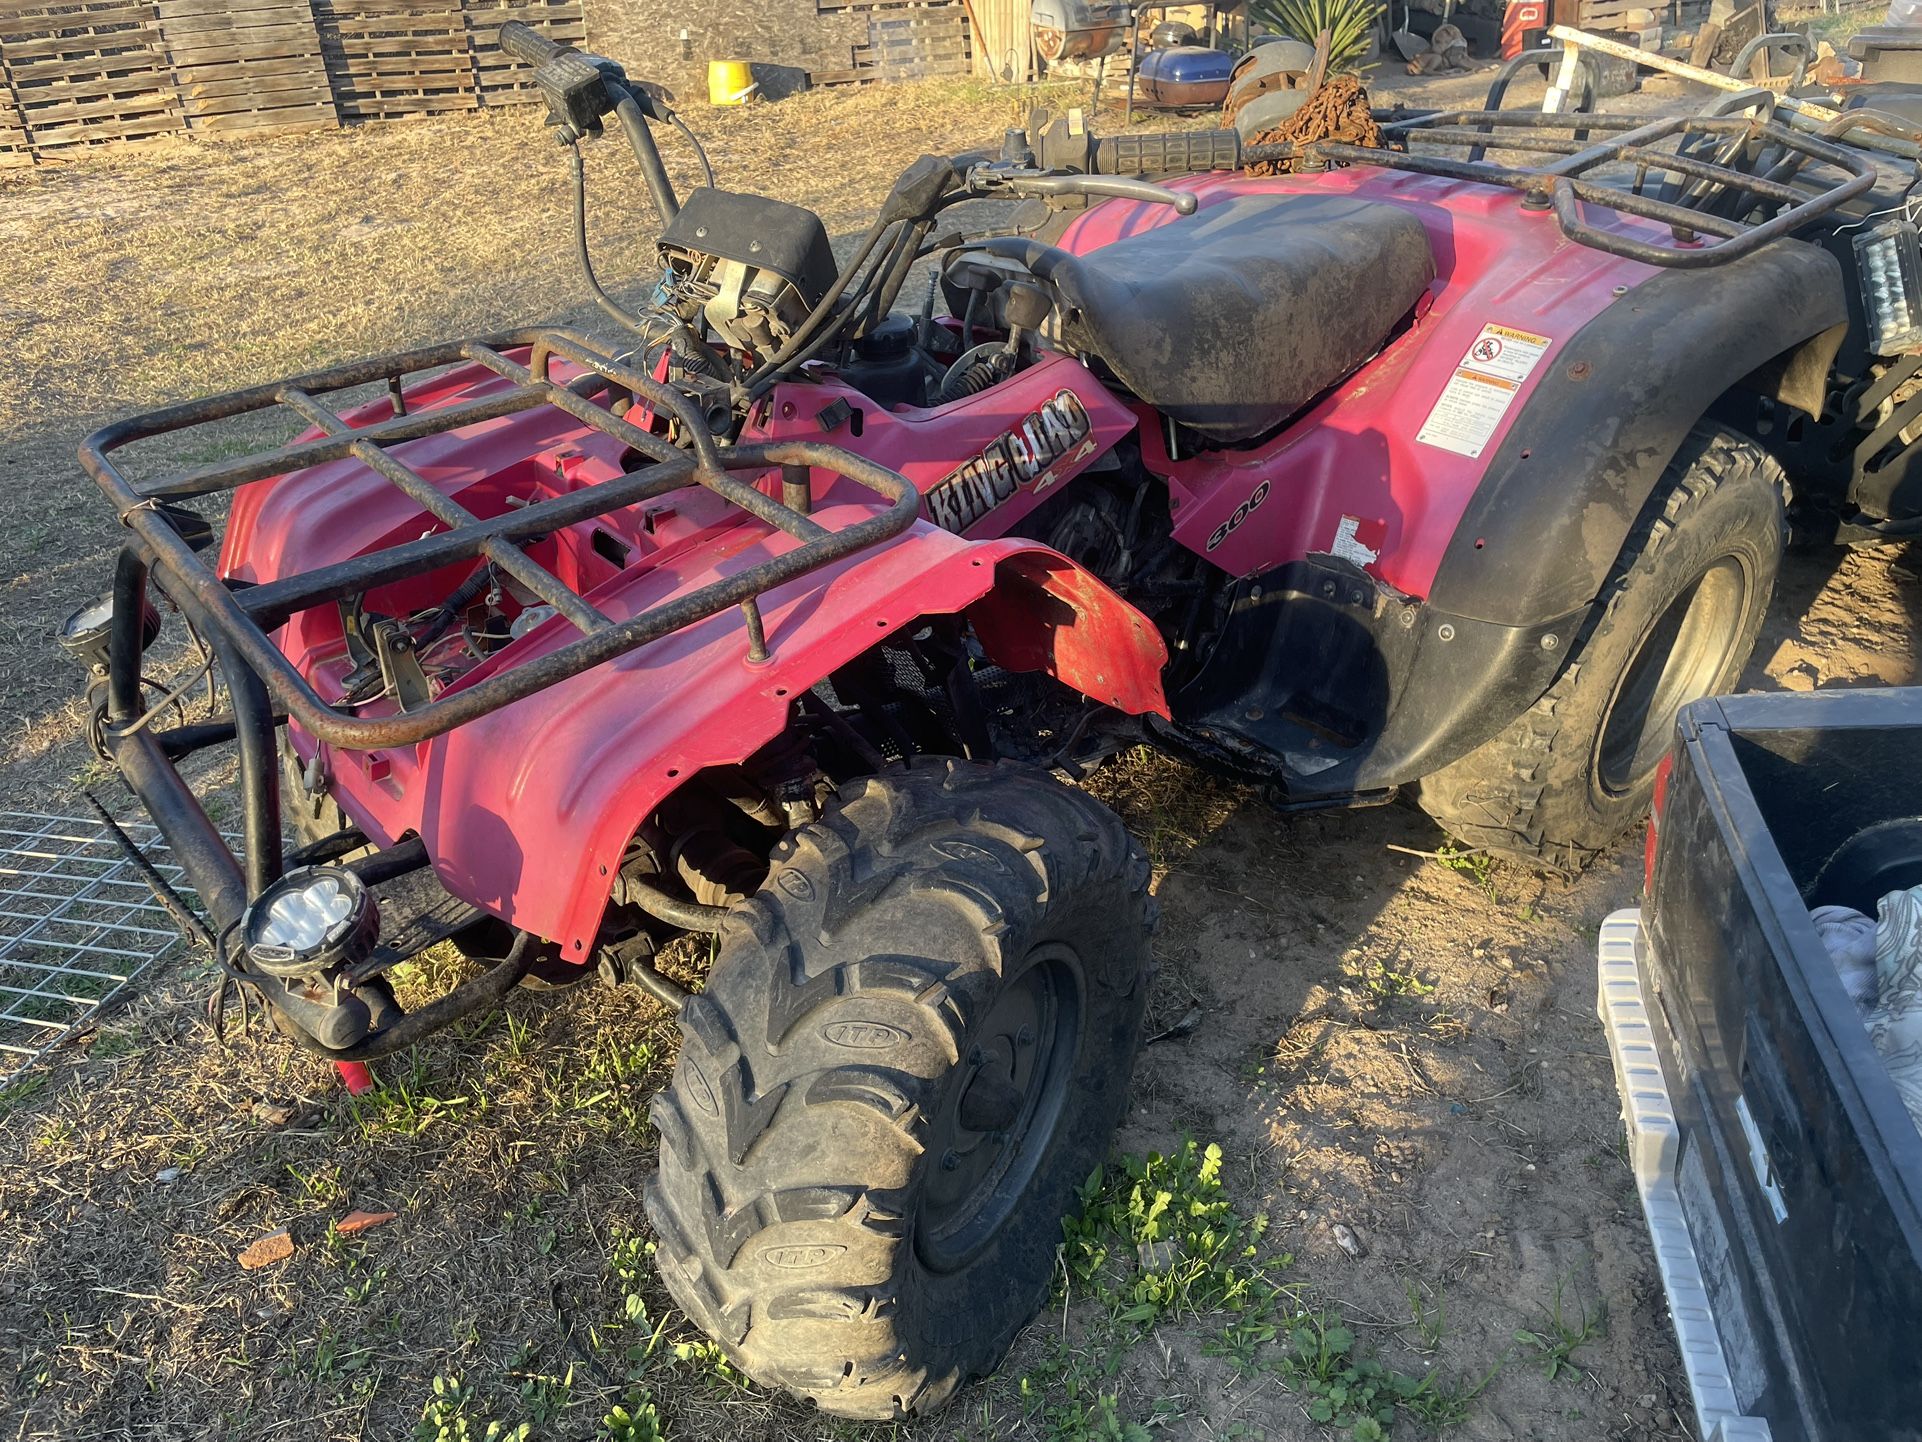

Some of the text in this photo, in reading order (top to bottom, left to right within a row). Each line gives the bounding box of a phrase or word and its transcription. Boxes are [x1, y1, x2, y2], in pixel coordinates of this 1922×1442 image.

[1504, 330, 1537, 344] WARNING
[1206, 479, 1271, 552] 300
[833, 1024, 891, 1046] ITP
[773, 1247, 826, 1265] ITP
